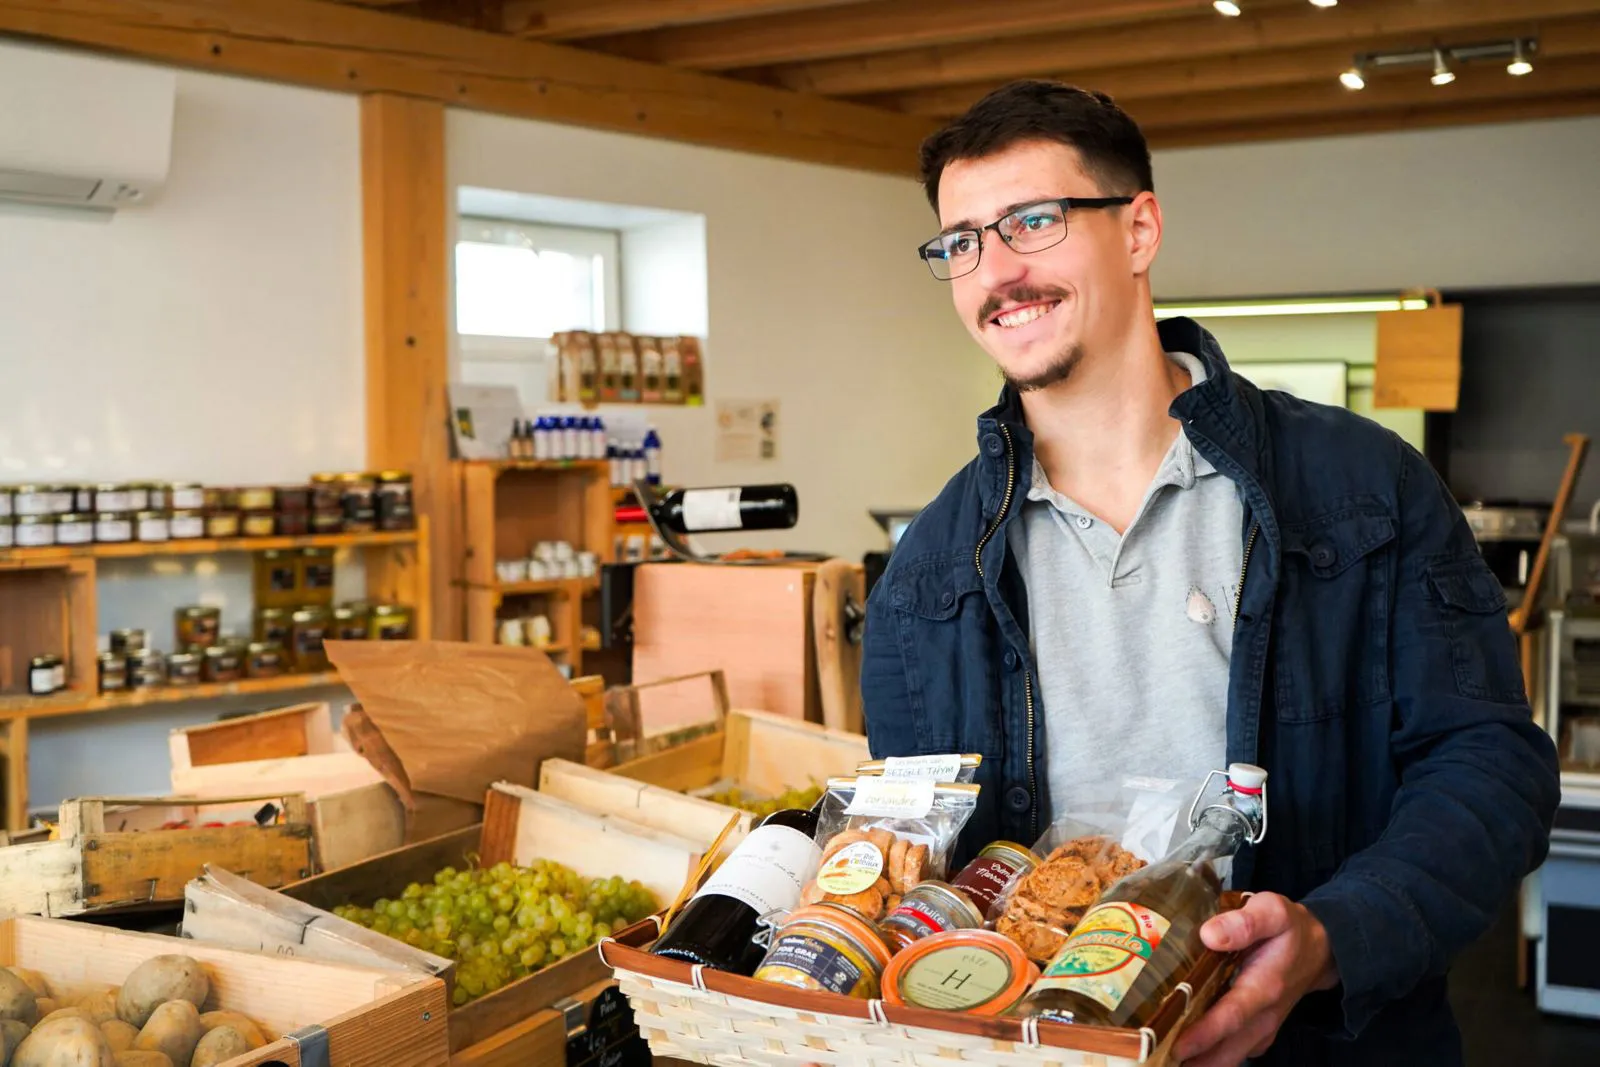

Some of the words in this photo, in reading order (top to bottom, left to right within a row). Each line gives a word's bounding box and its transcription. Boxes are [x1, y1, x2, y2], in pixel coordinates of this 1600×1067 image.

[926, 765, 955, 776] THYM
[916, 901, 946, 926] Truite
[795, 947, 818, 960] GRAS
[940, 968, 972, 990] H
